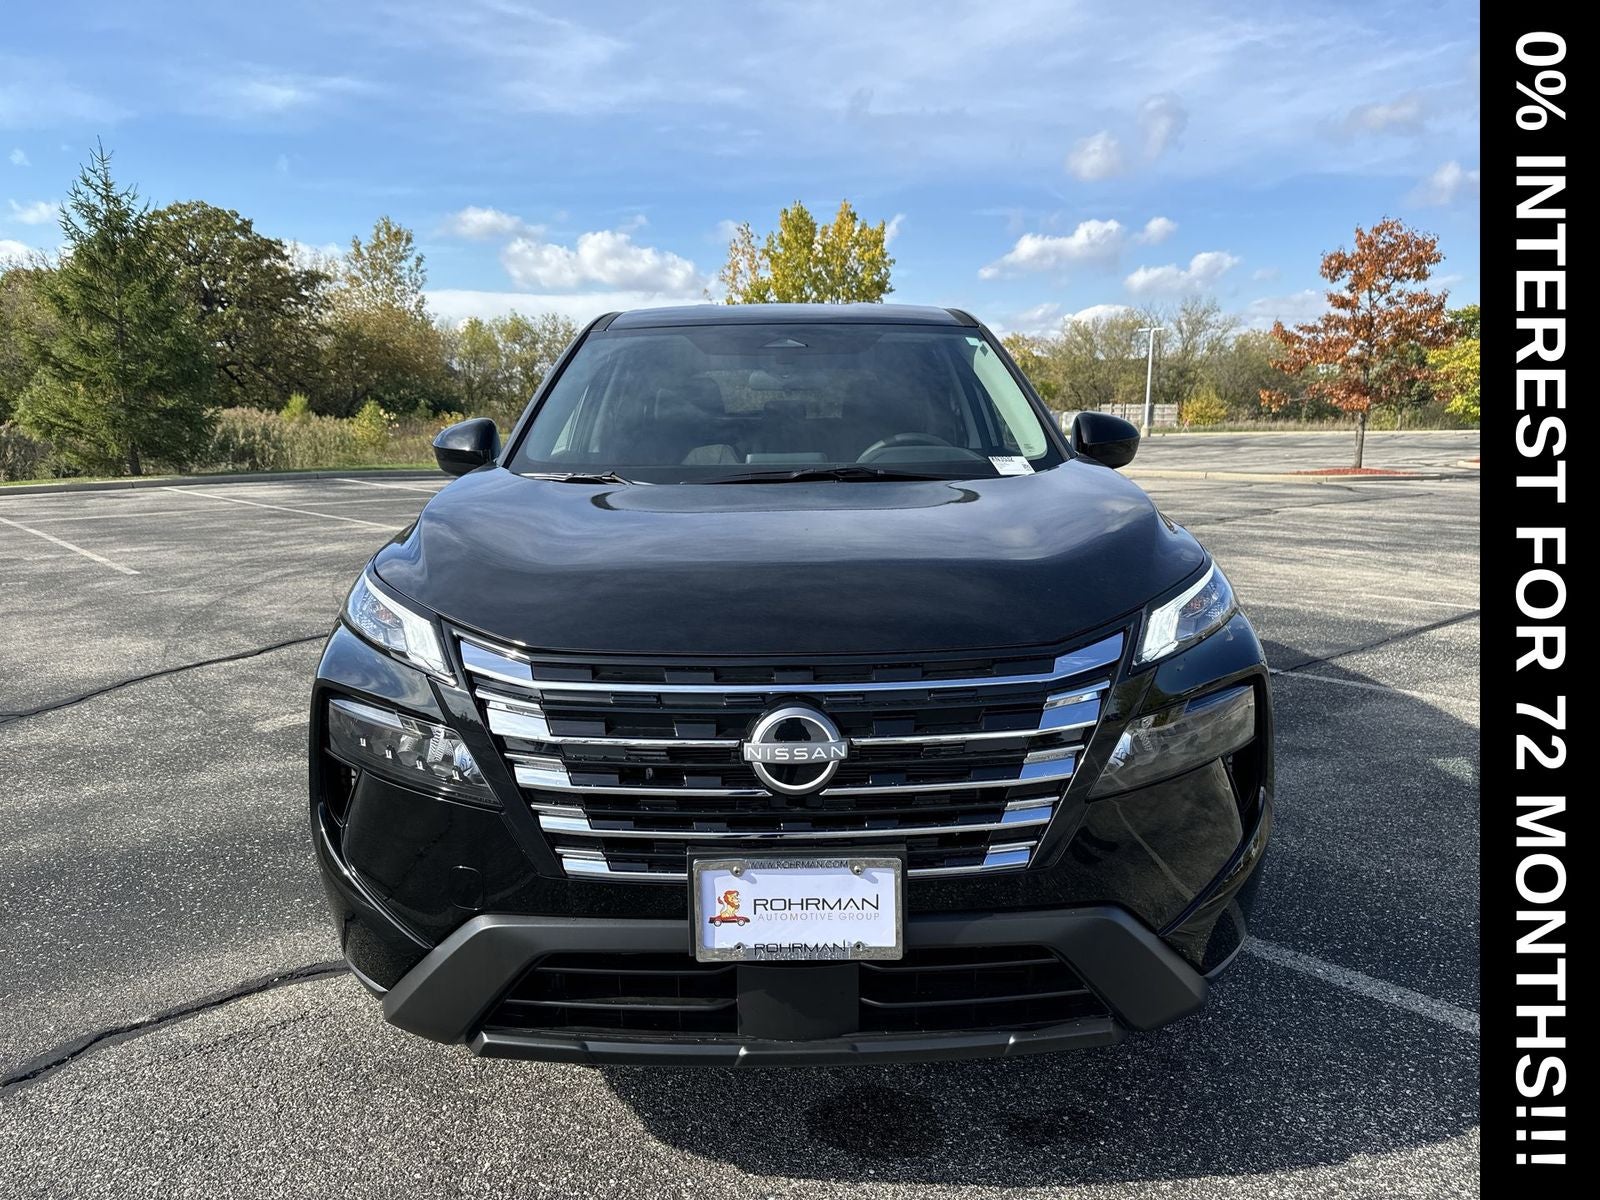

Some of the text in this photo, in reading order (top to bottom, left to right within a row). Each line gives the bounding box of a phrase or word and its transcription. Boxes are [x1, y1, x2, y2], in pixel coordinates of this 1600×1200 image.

[747, 745, 846, 760] NISSAN
[753, 894, 879, 915] ROHRMAN
[757, 911, 880, 921] AUTOMOTIVE GROUP
[754, 940, 846, 956] ROHRMAN
